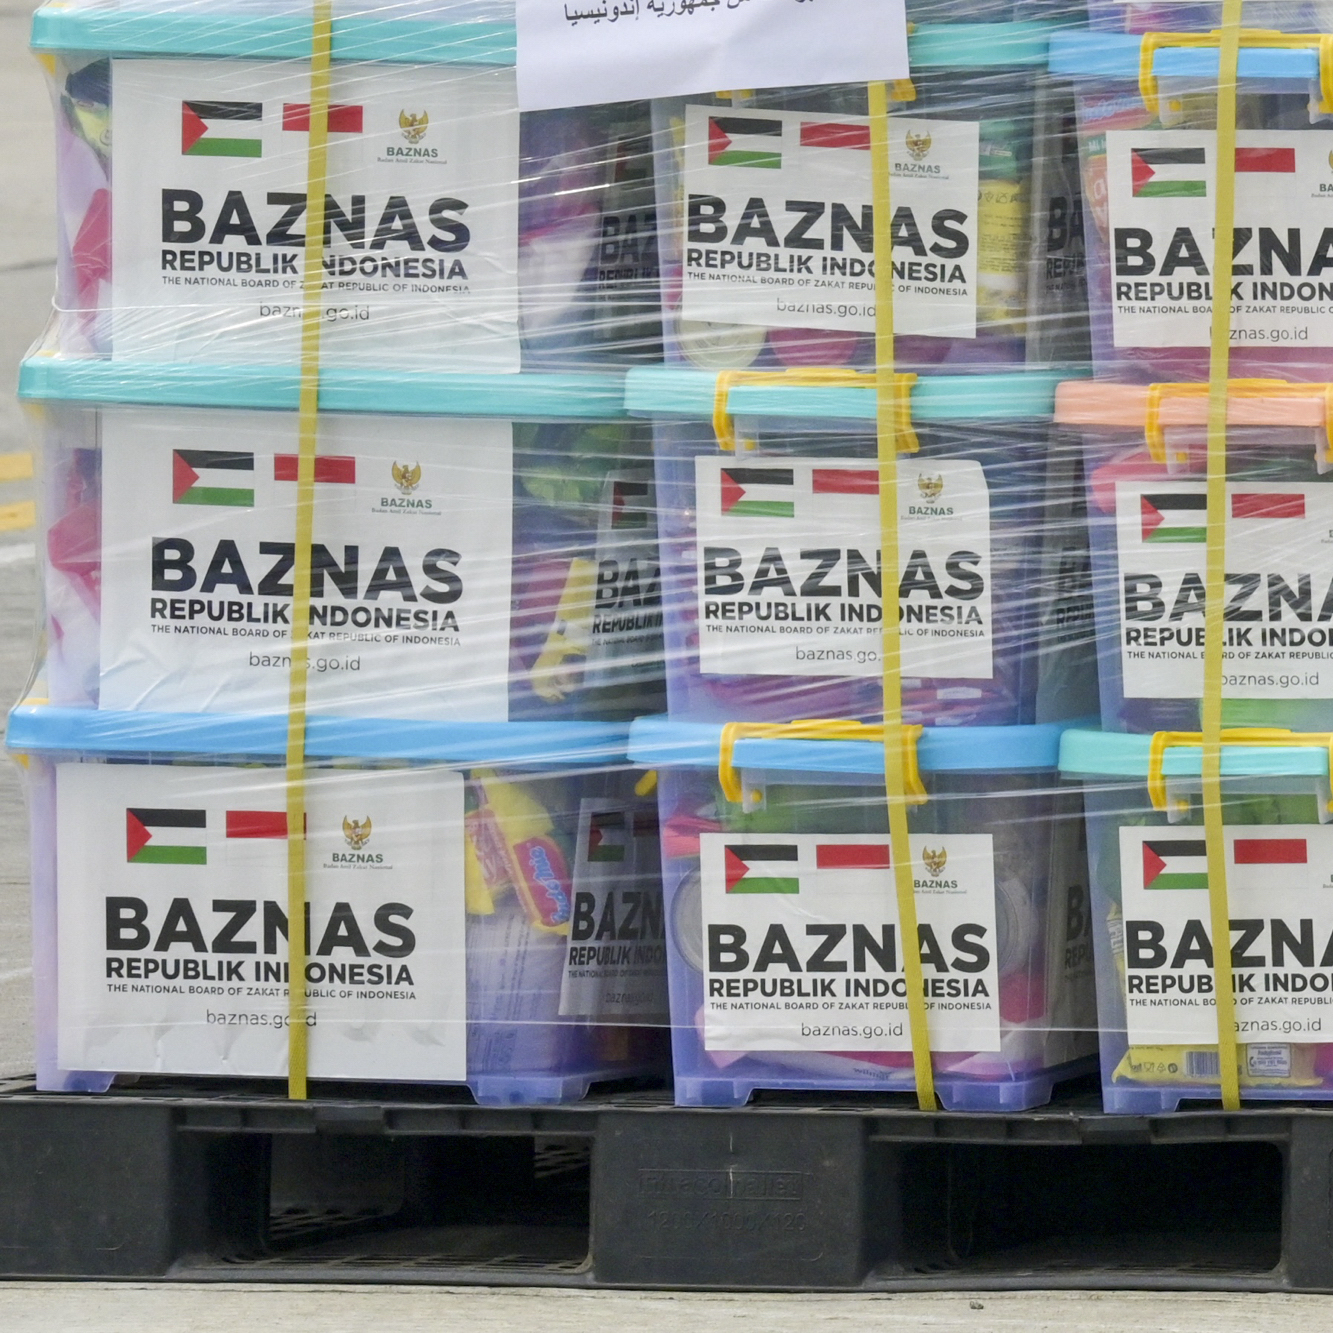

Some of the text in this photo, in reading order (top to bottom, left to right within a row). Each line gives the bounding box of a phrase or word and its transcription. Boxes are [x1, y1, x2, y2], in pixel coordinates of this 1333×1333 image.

[386, 147, 438, 157] BAZNAS
[895, 163, 941, 173] BAZNAS
[162, 188, 470, 253] BAZNAS
[688, 193, 969, 259] BAZNAS
[162, 249, 298, 275] REPUBLIK
[687, 248, 813, 275] REPUBLIK
[1116, 282, 1243, 302] REPUBLK
[380, 498, 432, 508] BAZNAS
[908, 506, 954, 516] BAZNAS
[152, 536, 463, 604] BAZNAS
[704, 546, 984, 600] BAZNAS
[150, 597, 459, 632] REPUBLIK NDONESIA
[705, 601, 832, 622] REPUBLIK
[332, 852, 384, 864] BAZNAS
[913, 880, 958, 889] BAZNAS
[105, 896, 416, 958] BAZNAS
[708, 923, 990, 973] BAZNAS
[105, 958, 414, 986] REPUBLIK INONESIA
[107, 984, 416, 1000] THE NATIONAL BOARD OF ZAKAT OF INDONESIA
[709, 978, 837, 997] REPUBLIK
[1128, 973, 1256, 994] REPUBIK
[710, 1002, 991, 1010] THE NATIONAL BOARD ZAKAT INDONESIA
[1257, 997, 1289, 1005] ZAKAT
[802, 1023, 903, 1039] baznas.go.id
